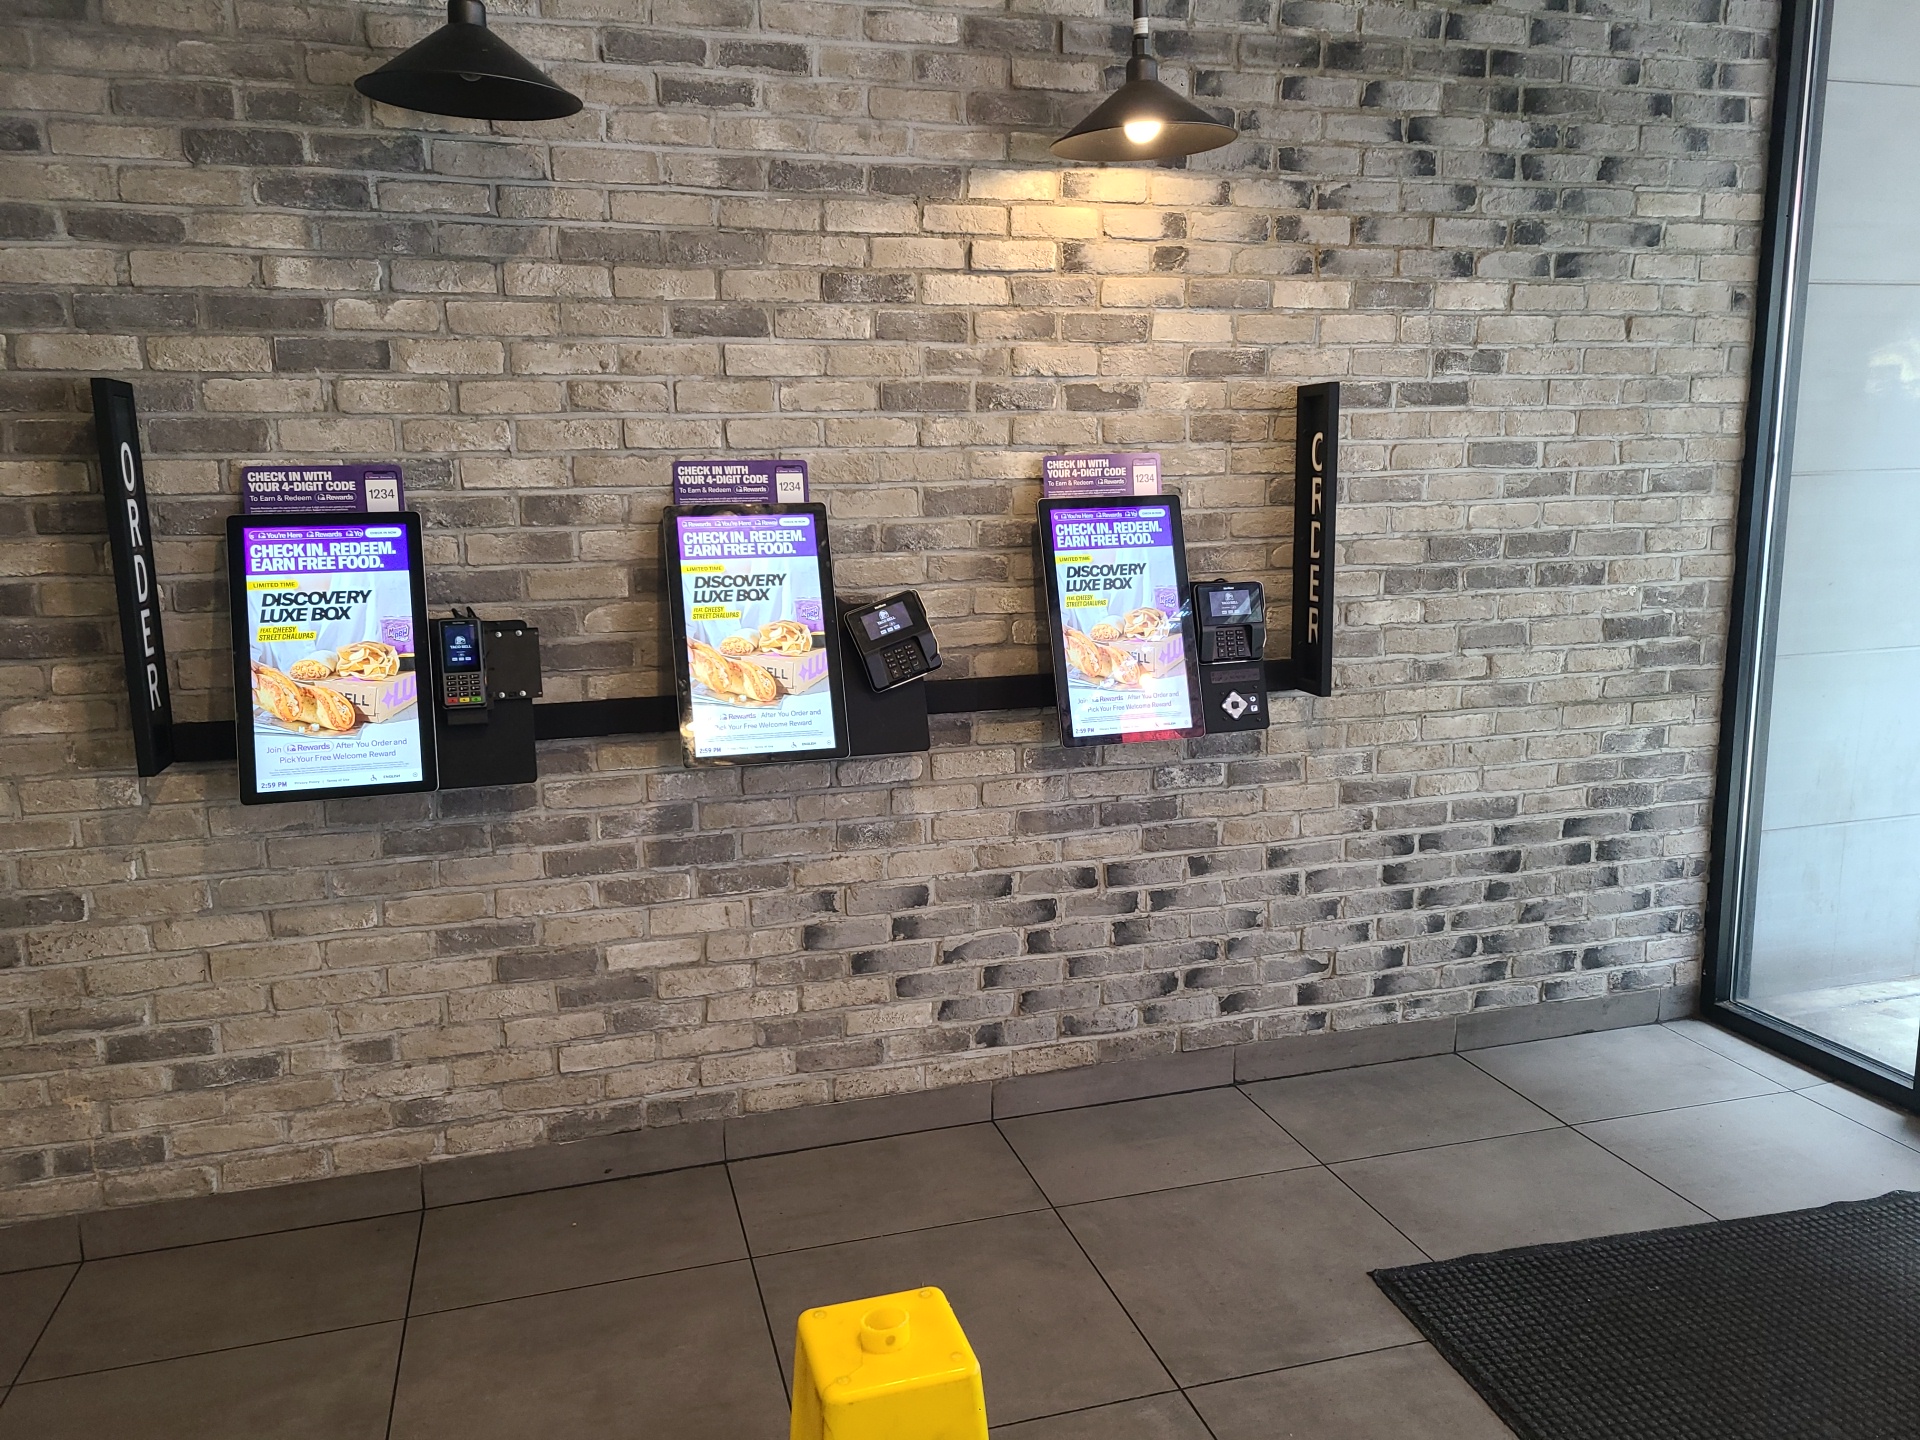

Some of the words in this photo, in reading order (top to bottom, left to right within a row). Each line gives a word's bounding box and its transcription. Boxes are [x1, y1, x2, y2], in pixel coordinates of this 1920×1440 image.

[678, 466, 710, 475] CHECK
[712, 466, 722, 475] IN
[724, 466, 748, 474] WITH
[1047, 461, 1075, 469] CHECK
[1077, 460, 1086, 468] IN
[1088, 459, 1109, 468] WITH
[248, 472, 286, 482] CHECK
[289, 472, 301, 481] IN
[304, 471, 332, 481] WITH
[678, 476, 705, 484] YOUR
[707, 475, 741, 484] 4-DIGIT
[744, 475, 768, 483] CODE
[1047, 469, 1070, 478] YOUR
[1072, 469, 1102, 477] 4-DIGIT
[1104, 468, 1126, 476] CODE
[1136, 474, 1154, 483] 1234
[248, 482, 280, 492] YOUR
[282, 482, 323, 491] 4-DIGIT
[326, 481, 356, 491] CODE
[779, 482, 800, 492] 1234
[369, 489, 395, 499] 1234
[1056, 524, 1095, 535] CHECK
[1096, 523, 1112, 533] IN.
[1114, 521, 1162, 532] REDEEM.
[683, 532, 729, 544] CHECK
[730, 532, 748, 543] IN.
[750, 530, 806, 542] REDEEM.
[1057, 535, 1089, 547] EARN
[1091, 534, 1119, 546] FREE
[1121, 533, 1154, 544] FOOD.
[250, 543, 305, 558] CHECK
[307, 543, 327, 556] IN.
[329, 542, 396, 555] REDEEM.
[684, 544, 722, 557] EARN
[724, 544, 756, 555] FREE
[758, 543, 796, 554] FOOD.
[252, 557, 295, 572] EARN
[299, 556, 336, 570] FREE
[338, 556, 384, 569] FOOD.
[1067, 563, 1146, 578] DISCOVERY
[120, 441, 162, 711] ORDER
[694, 573, 787, 588] DISCOVERY
[1066, 579, 1101, 592] LUXE
[1104, 578, 1132, 590] BOX
[262, 590, 372, 607] DISCOVERY
[693, 589, 733, 603] LUXE
[736, 588, 770, 601] BOX
[260, 608, 308, 623] LUXE
[311, 606, 352, 621] BOX
[259, 633, 282, 641] STREET
[298, 743, 330, 751] Rewards
